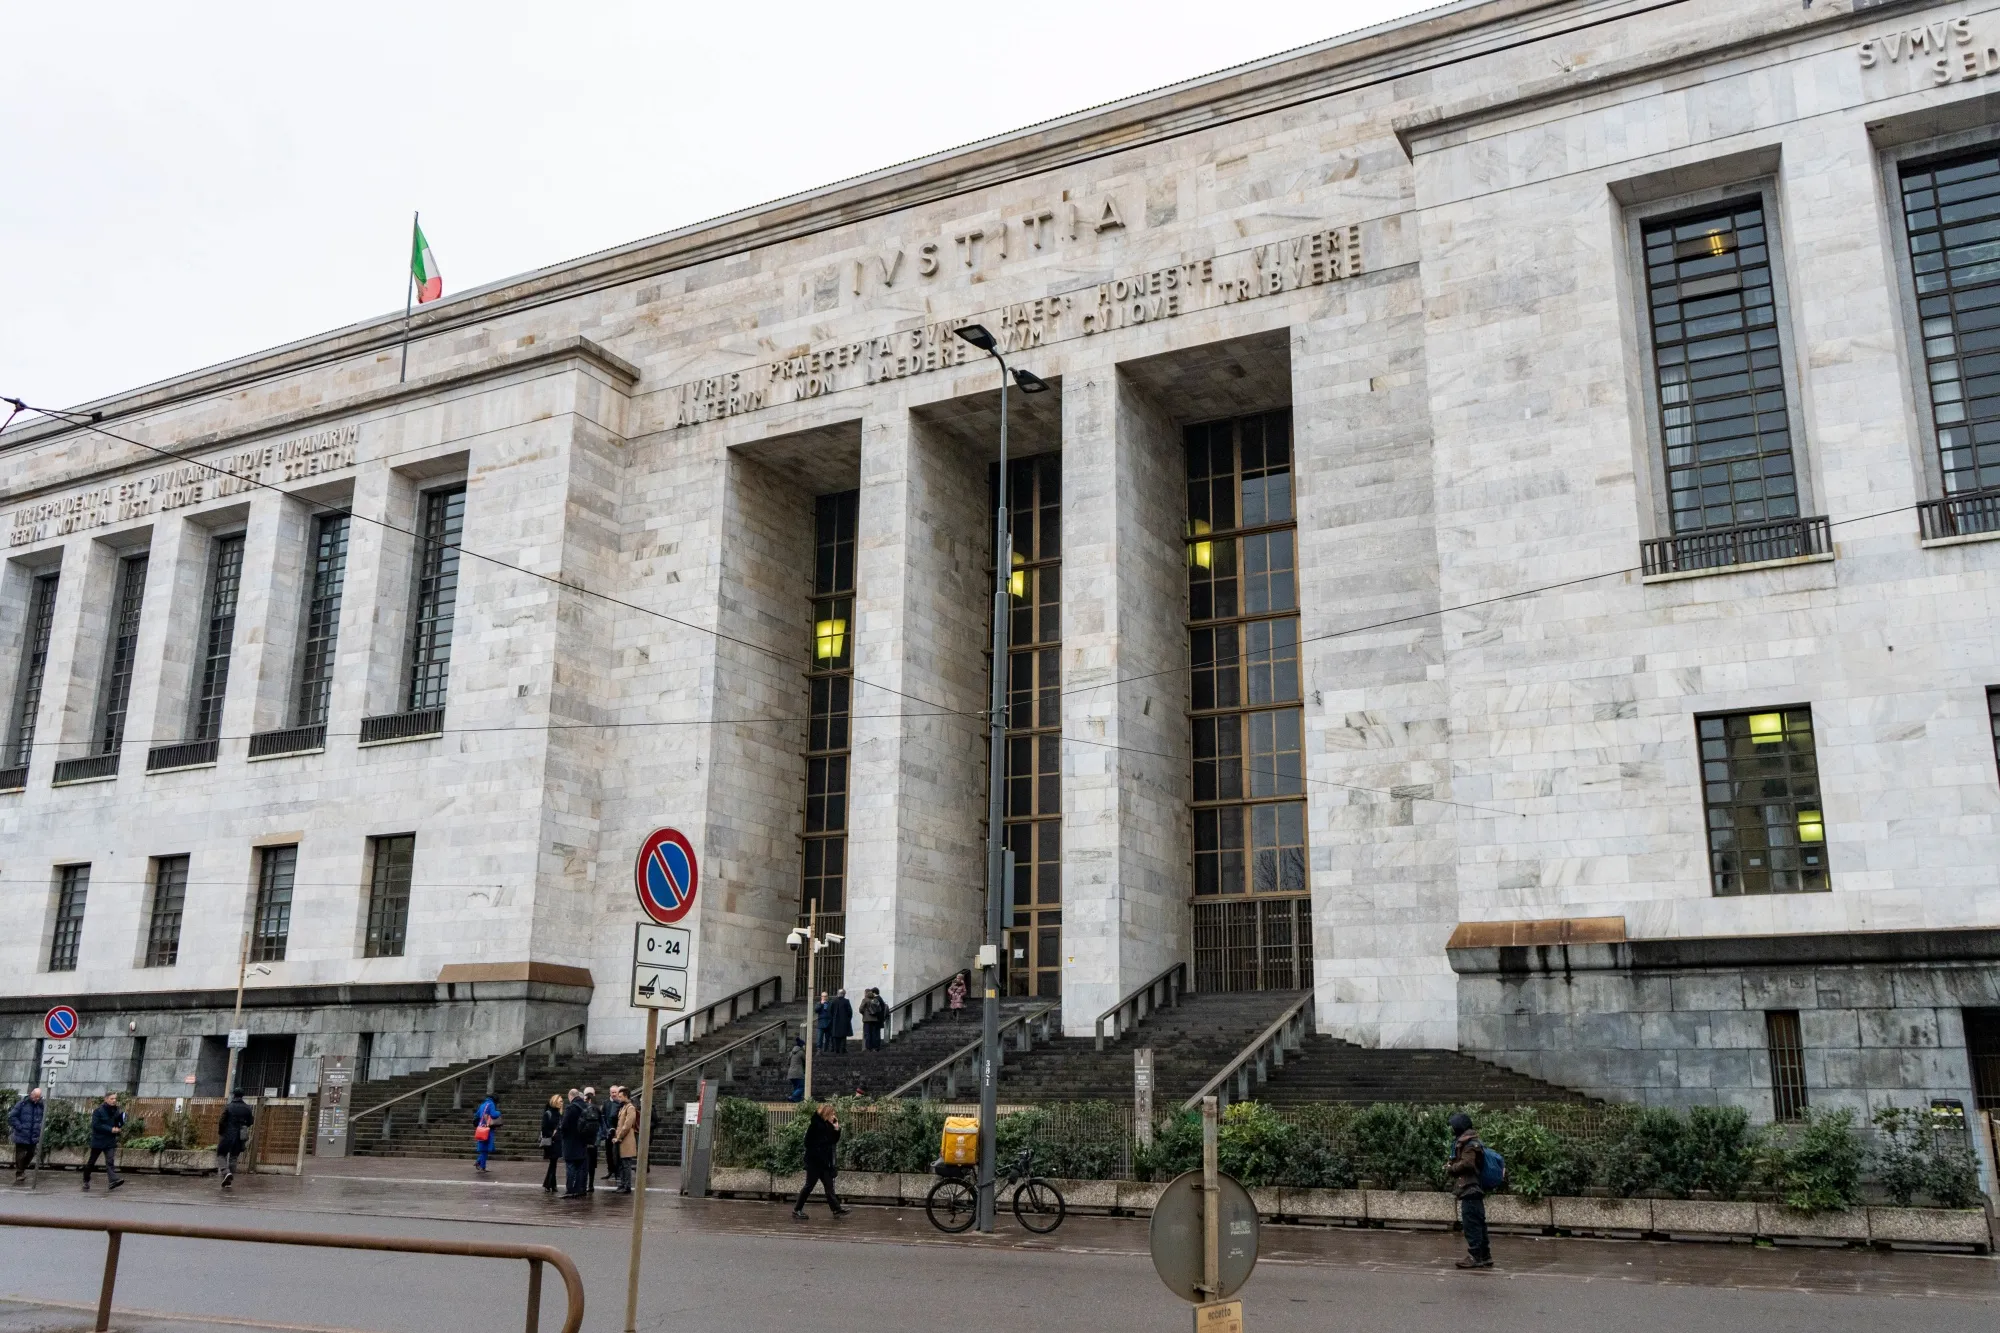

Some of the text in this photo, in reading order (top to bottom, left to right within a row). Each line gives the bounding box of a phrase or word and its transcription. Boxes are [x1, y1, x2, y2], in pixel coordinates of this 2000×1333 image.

[1859, 15, 1972, 69] SVMVS
[852, 193, 1126, 296] IVSTITIA
[676, 253, 1361, 428] ALTERVM NON LAEDERE VVM CVIQVE TRIBVERE
[681, 373, 740, 404] IVRIS
[769, 334, 893, 383] PRAECEPTA
[1097, 258, 1213, 306] HONESTE
[1254, 225, 1359, 269] VIVERE
[119, 481, 144, 501] EST
